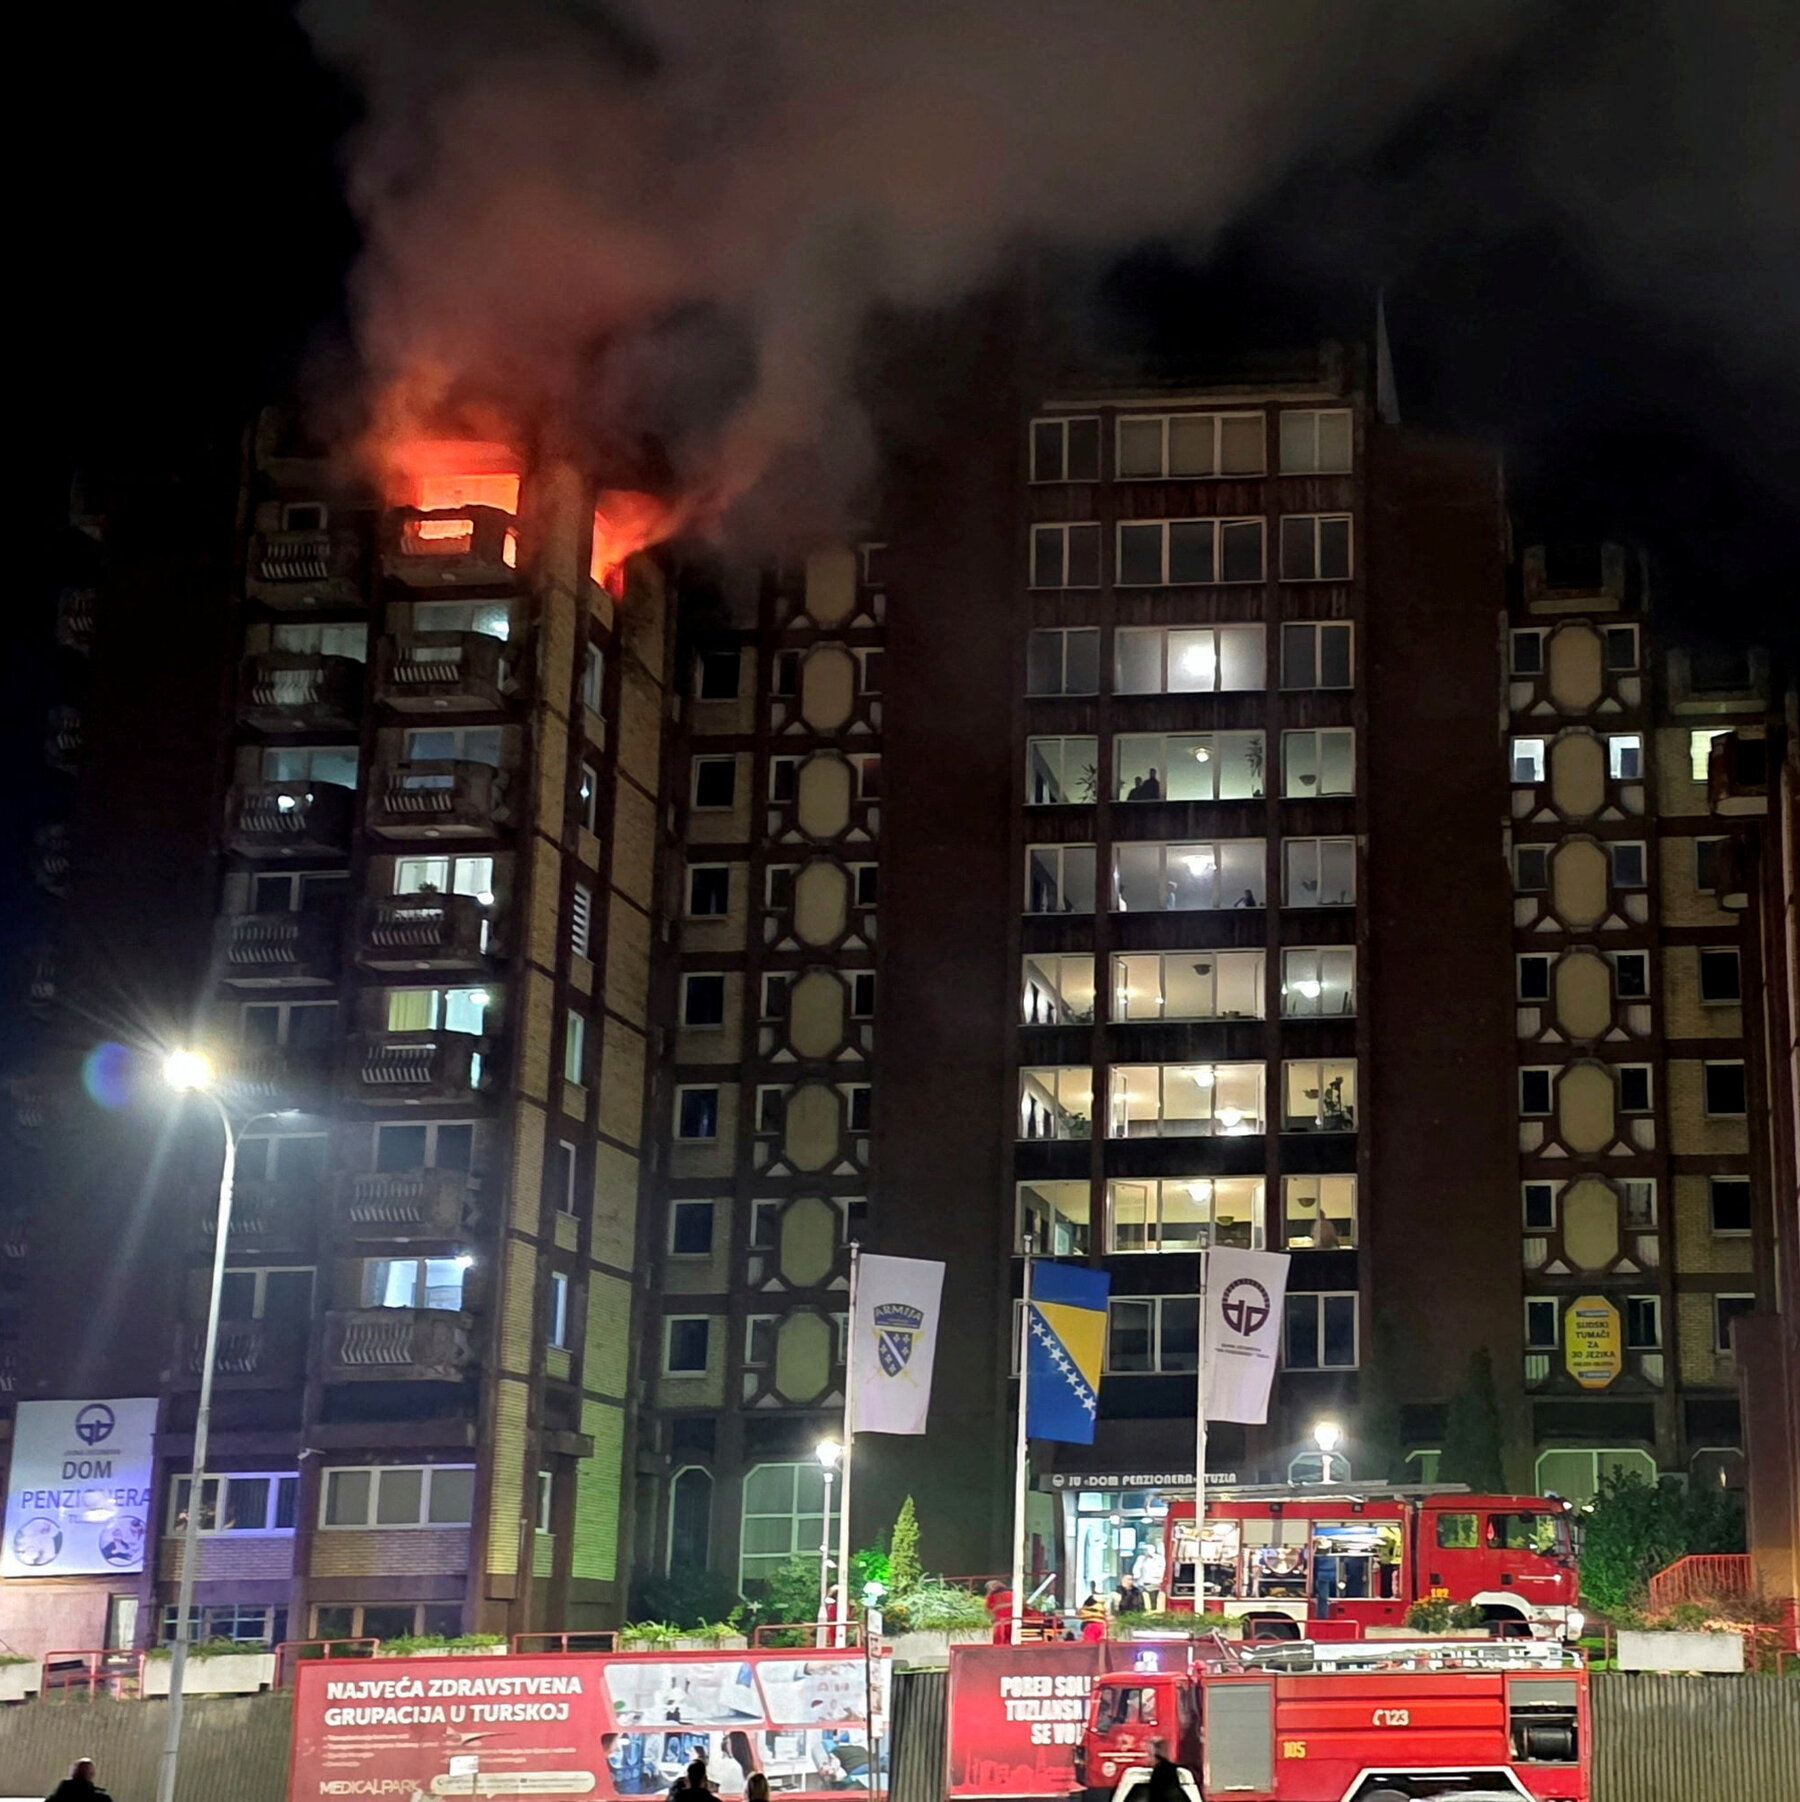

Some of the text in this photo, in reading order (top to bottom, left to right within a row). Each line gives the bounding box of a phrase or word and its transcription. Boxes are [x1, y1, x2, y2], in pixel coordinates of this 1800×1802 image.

[874, 1305, 922, 1321] ARMIJA
[1587, 1341, 1599, 1349] ZA
[62, 1460, 112, 1480] DOM
[1202, 1472, 1238, 1485] TUZLA
[326, 1676, 583, 1700] NAJVEĆA ZDRAVSTVENA
[324, 1702, 570, 1726] GRUPACIJA U TURSKOJ
[1030, 1722, 1052, 1745] SE
[1283, 1741, 1306, 1758] 105
